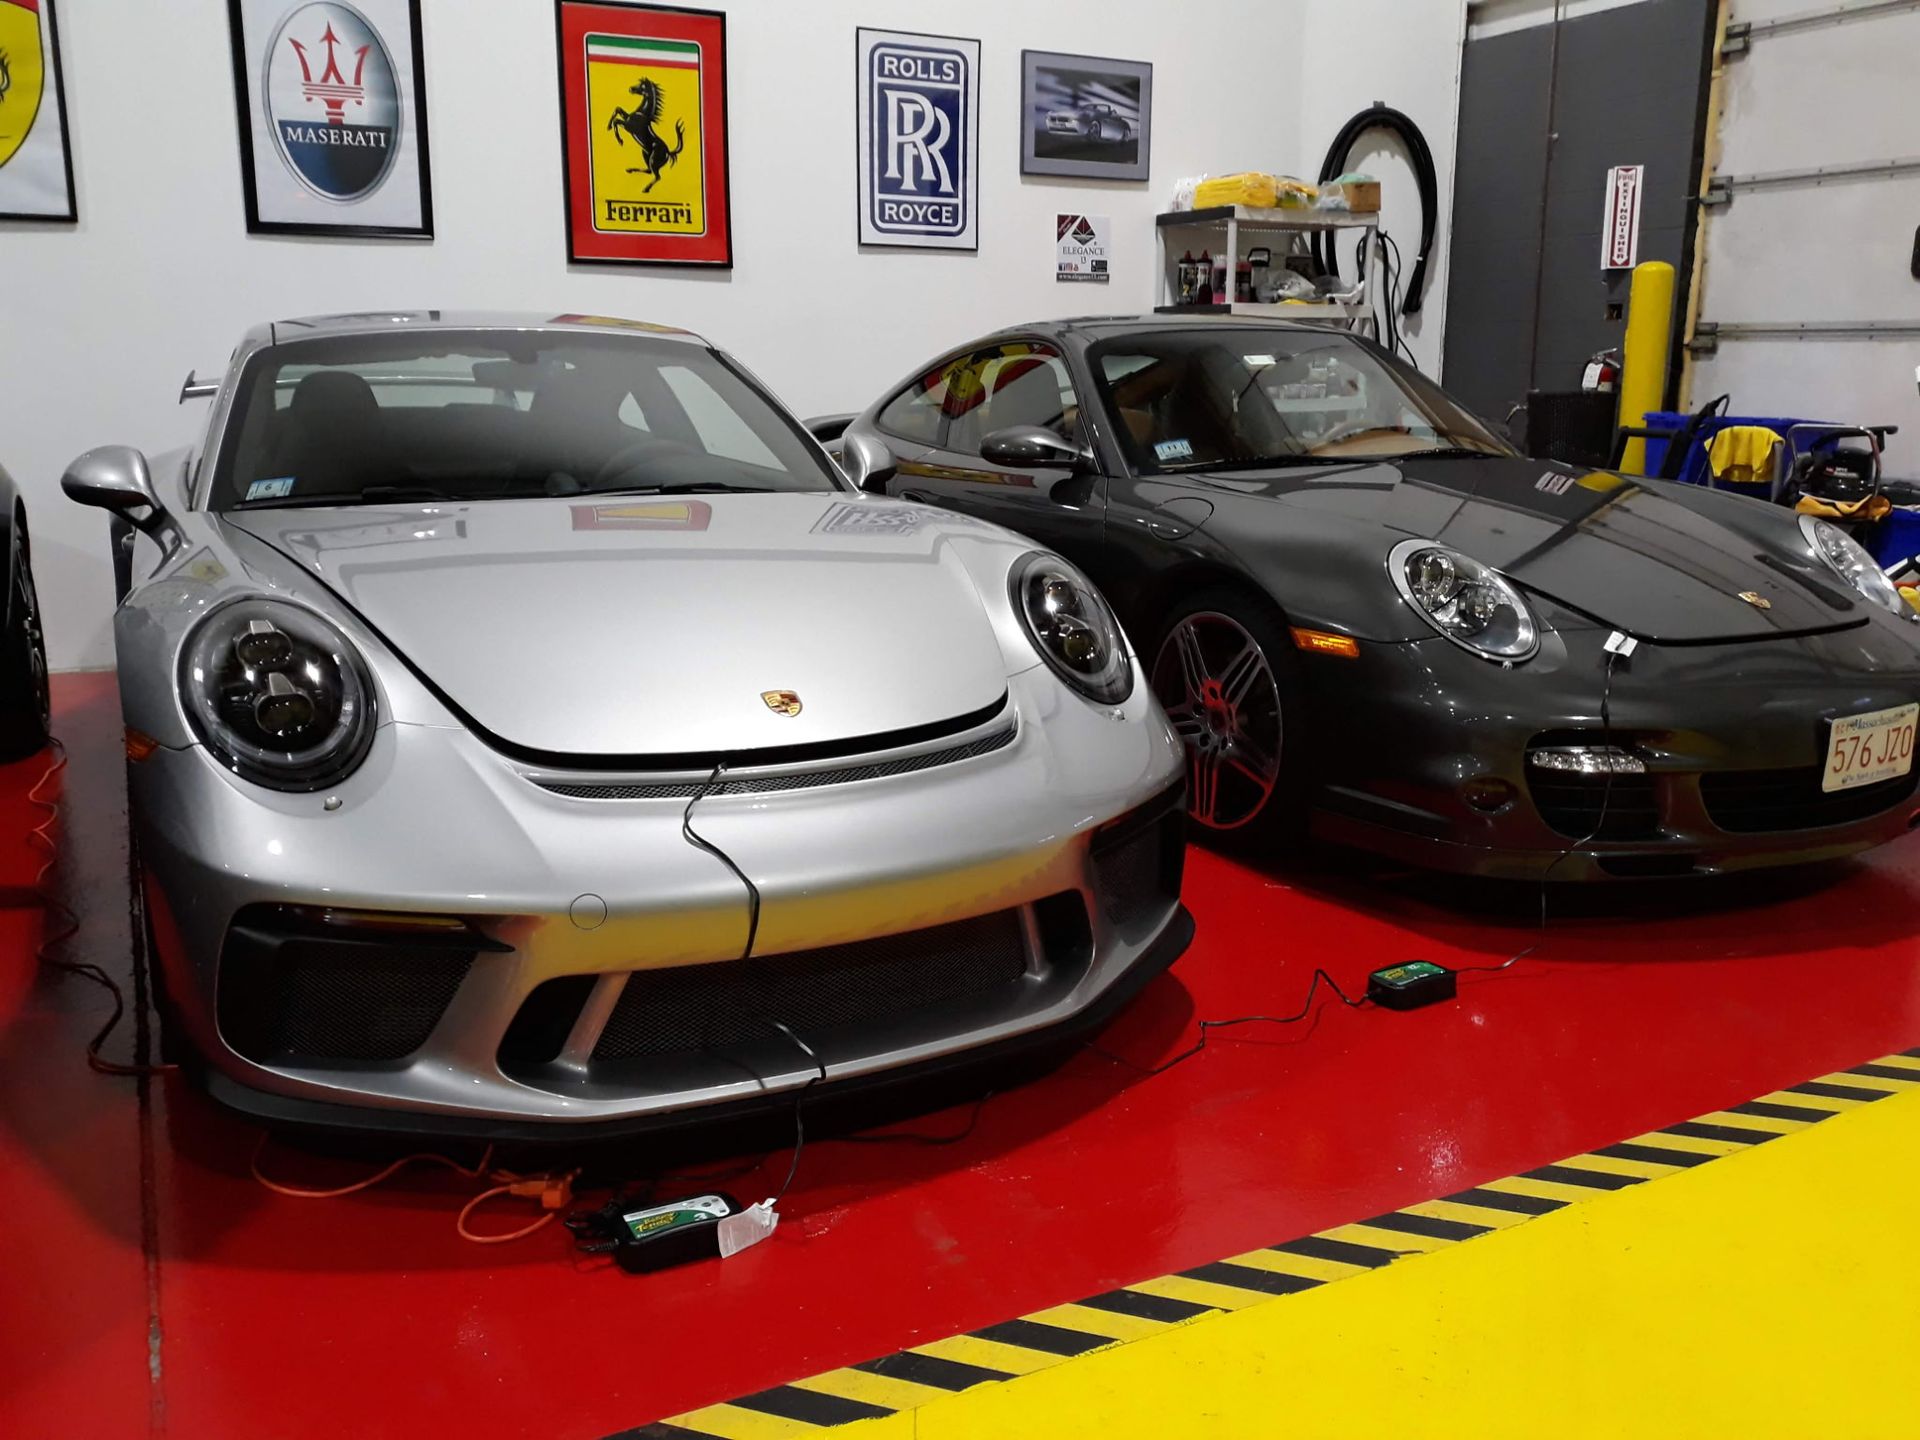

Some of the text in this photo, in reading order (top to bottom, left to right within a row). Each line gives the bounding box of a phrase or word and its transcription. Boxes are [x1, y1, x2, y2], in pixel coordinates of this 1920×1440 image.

[883, 55, 955, 81] ROLLS
[286, 126, 386, 148] MASERATI
[605, 199, 692, 225] Ferrari
[883, 202, 954, 224] ROYCE
[1616, 182, 1629, 259] EXTINGUISHER
[1062, 246, 1105, 256] ELEGANCE
[1832, 733, 1874, 774] 576
